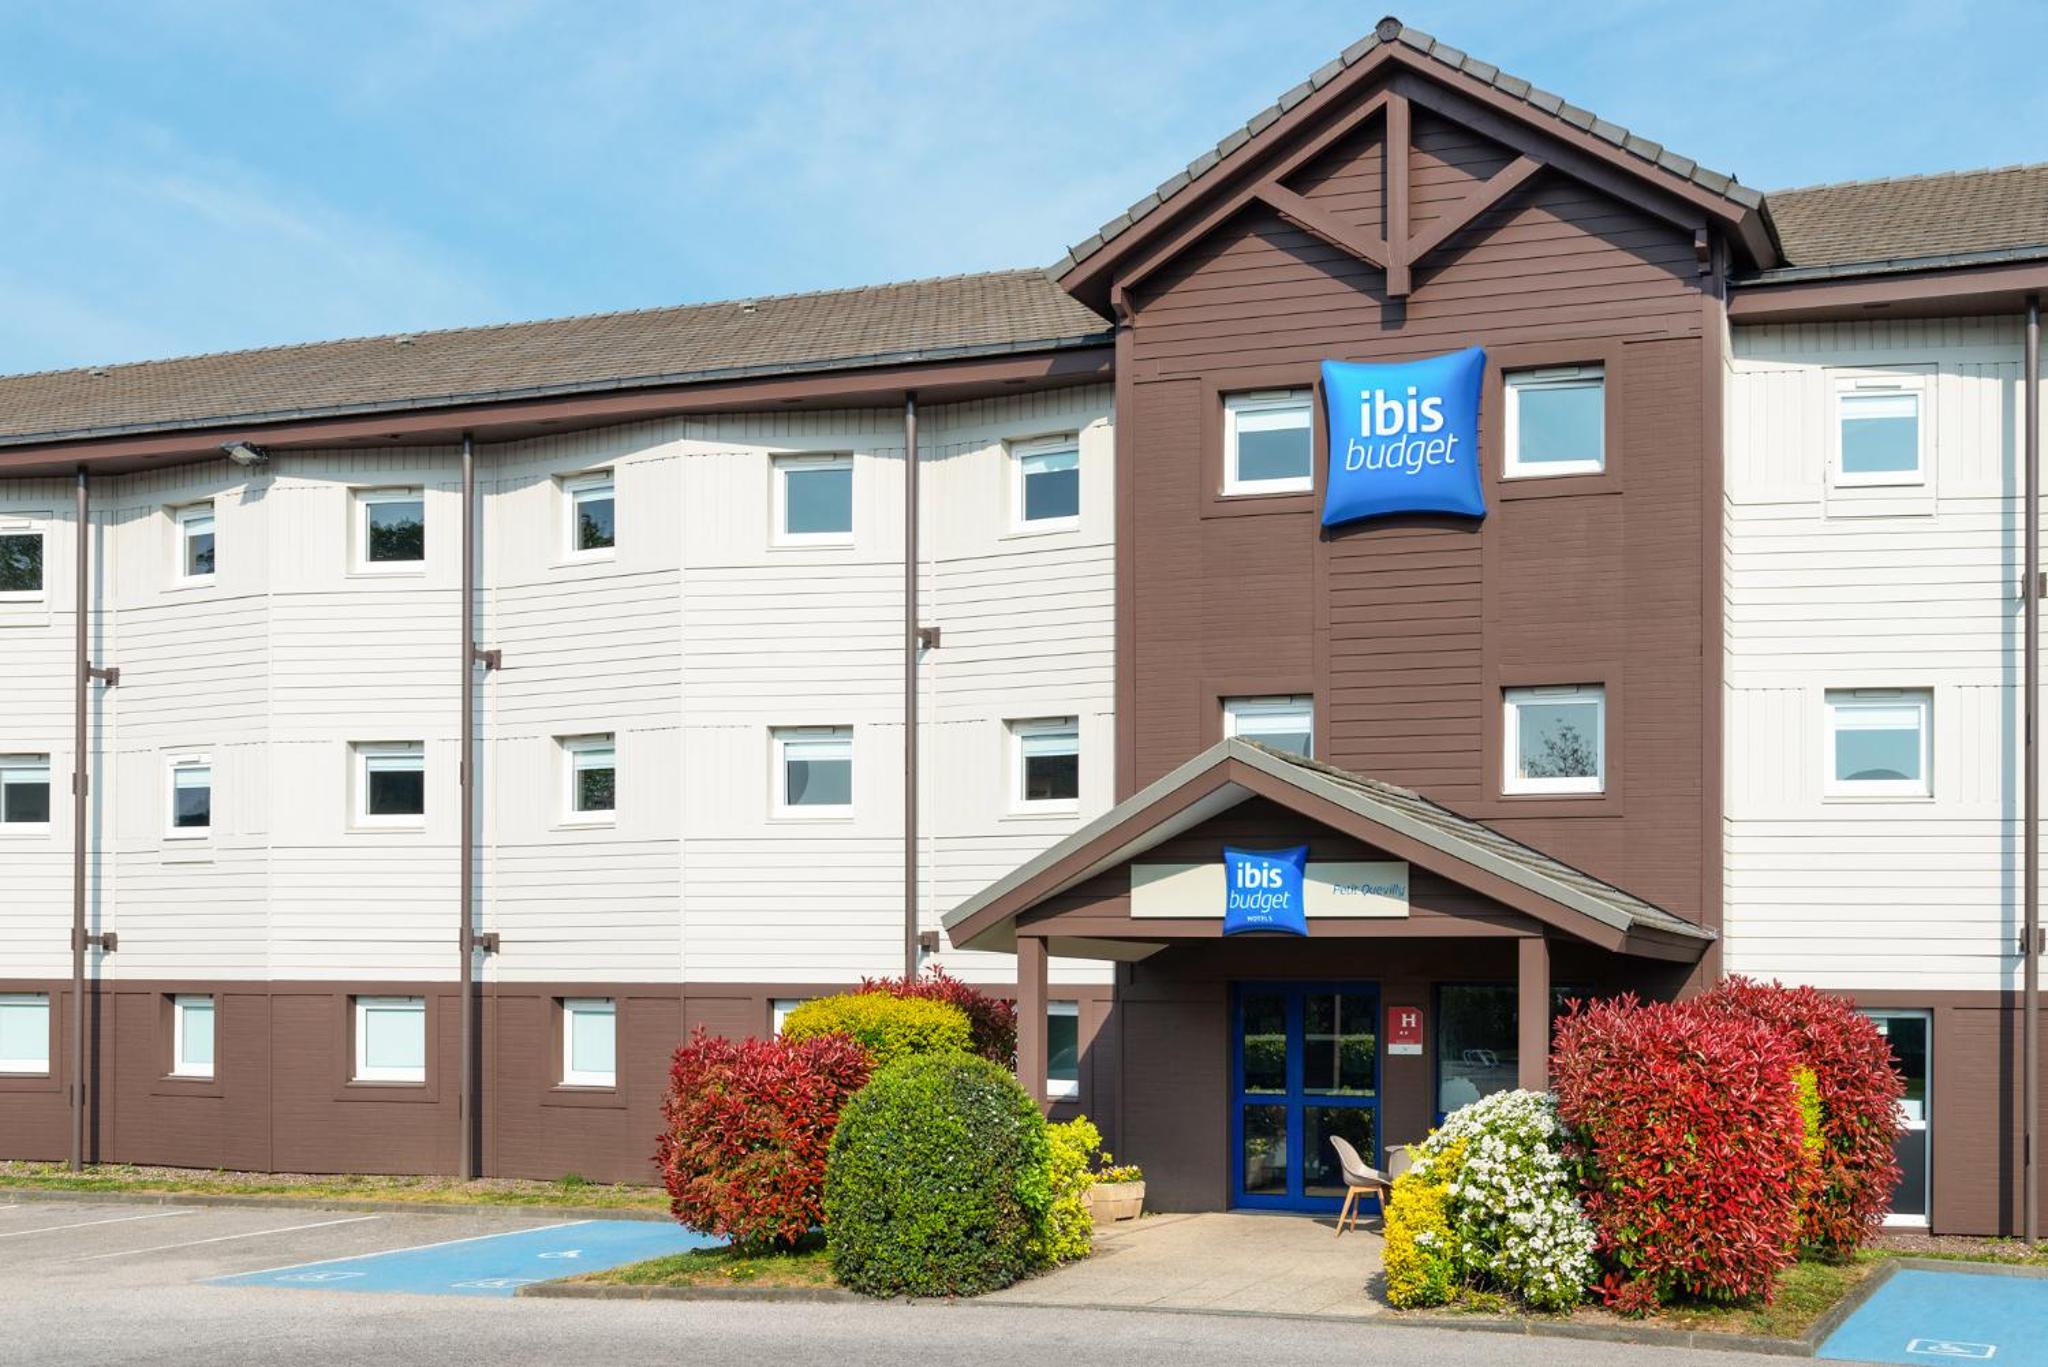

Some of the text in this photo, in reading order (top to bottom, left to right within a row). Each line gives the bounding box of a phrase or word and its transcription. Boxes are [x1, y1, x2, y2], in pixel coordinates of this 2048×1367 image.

[1360, 386, 1444, 437] ibis
[1345, 433, 1459, 475] budget
[1237, 861, 1283, 888] ibis
[1229, 889, 1291, 913] budget
[1401, 1013, 1417, 1028] H
